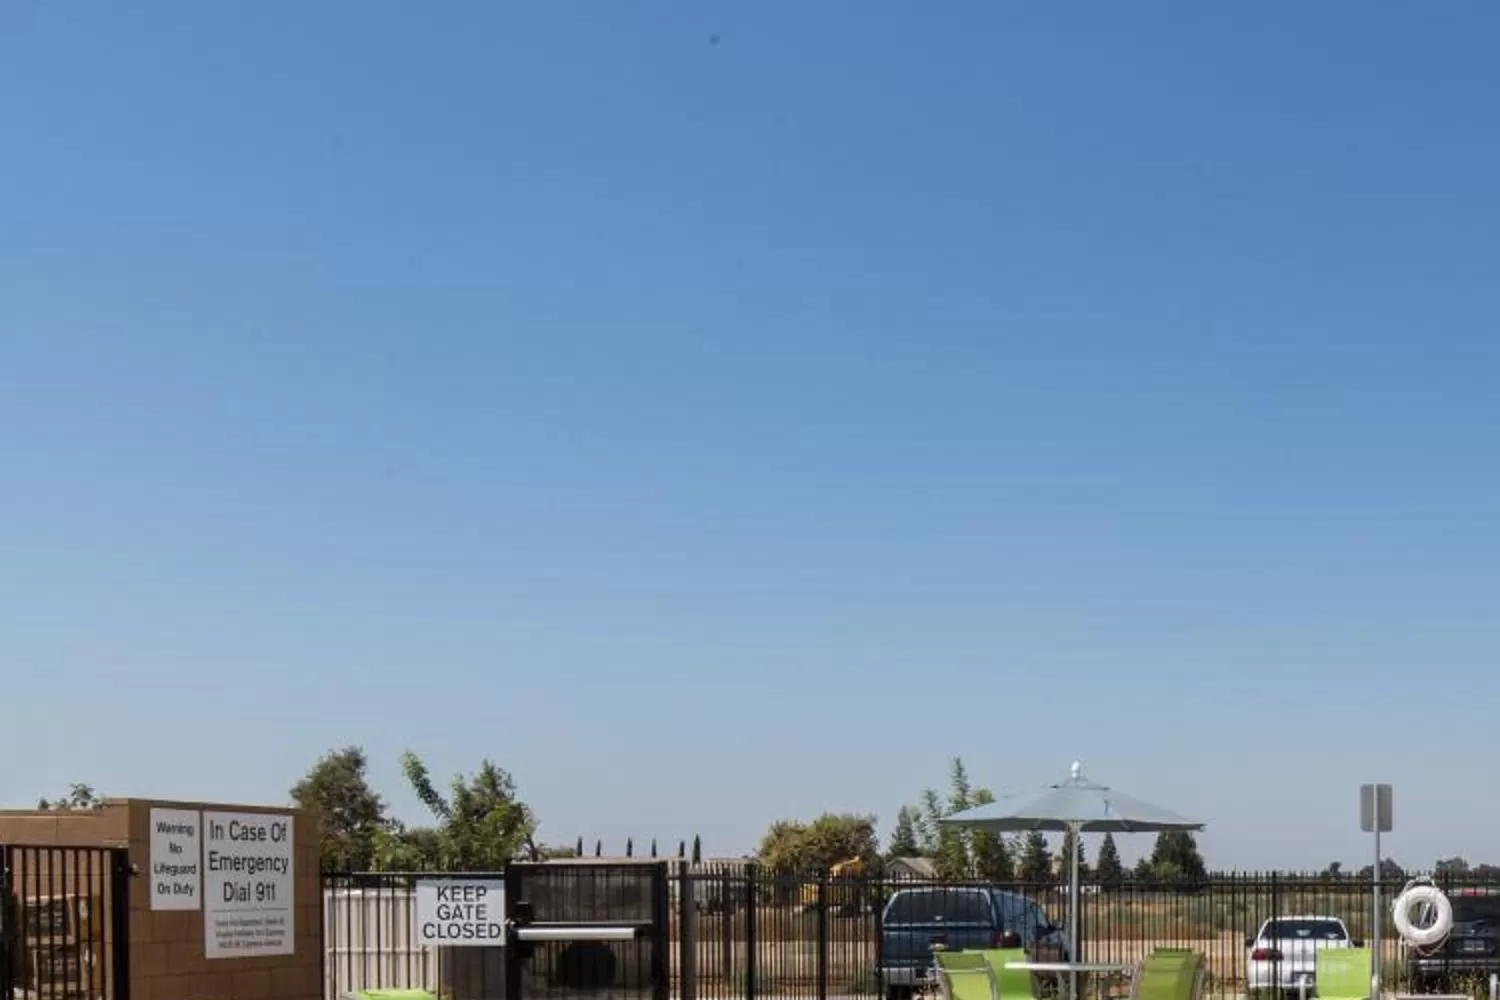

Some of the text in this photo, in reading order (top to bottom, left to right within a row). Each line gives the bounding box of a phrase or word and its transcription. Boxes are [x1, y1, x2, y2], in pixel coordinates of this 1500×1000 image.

[156, 821, 194, 837] Warning
[210, 820, 287, 843] In Case Of
[169, 842, 183, 854] No
[154, 862, 197, 877] Lifeguard
[209, 851, 289, 875] Emergency
[157, 883, 194, 897] On Duty
[223, 882, 276, 903] Dial 911
[437, 885, 487, 903] KEEP
[436, 904, 488, 921] GATE
[423, 923, 501, 939] CLOSED
